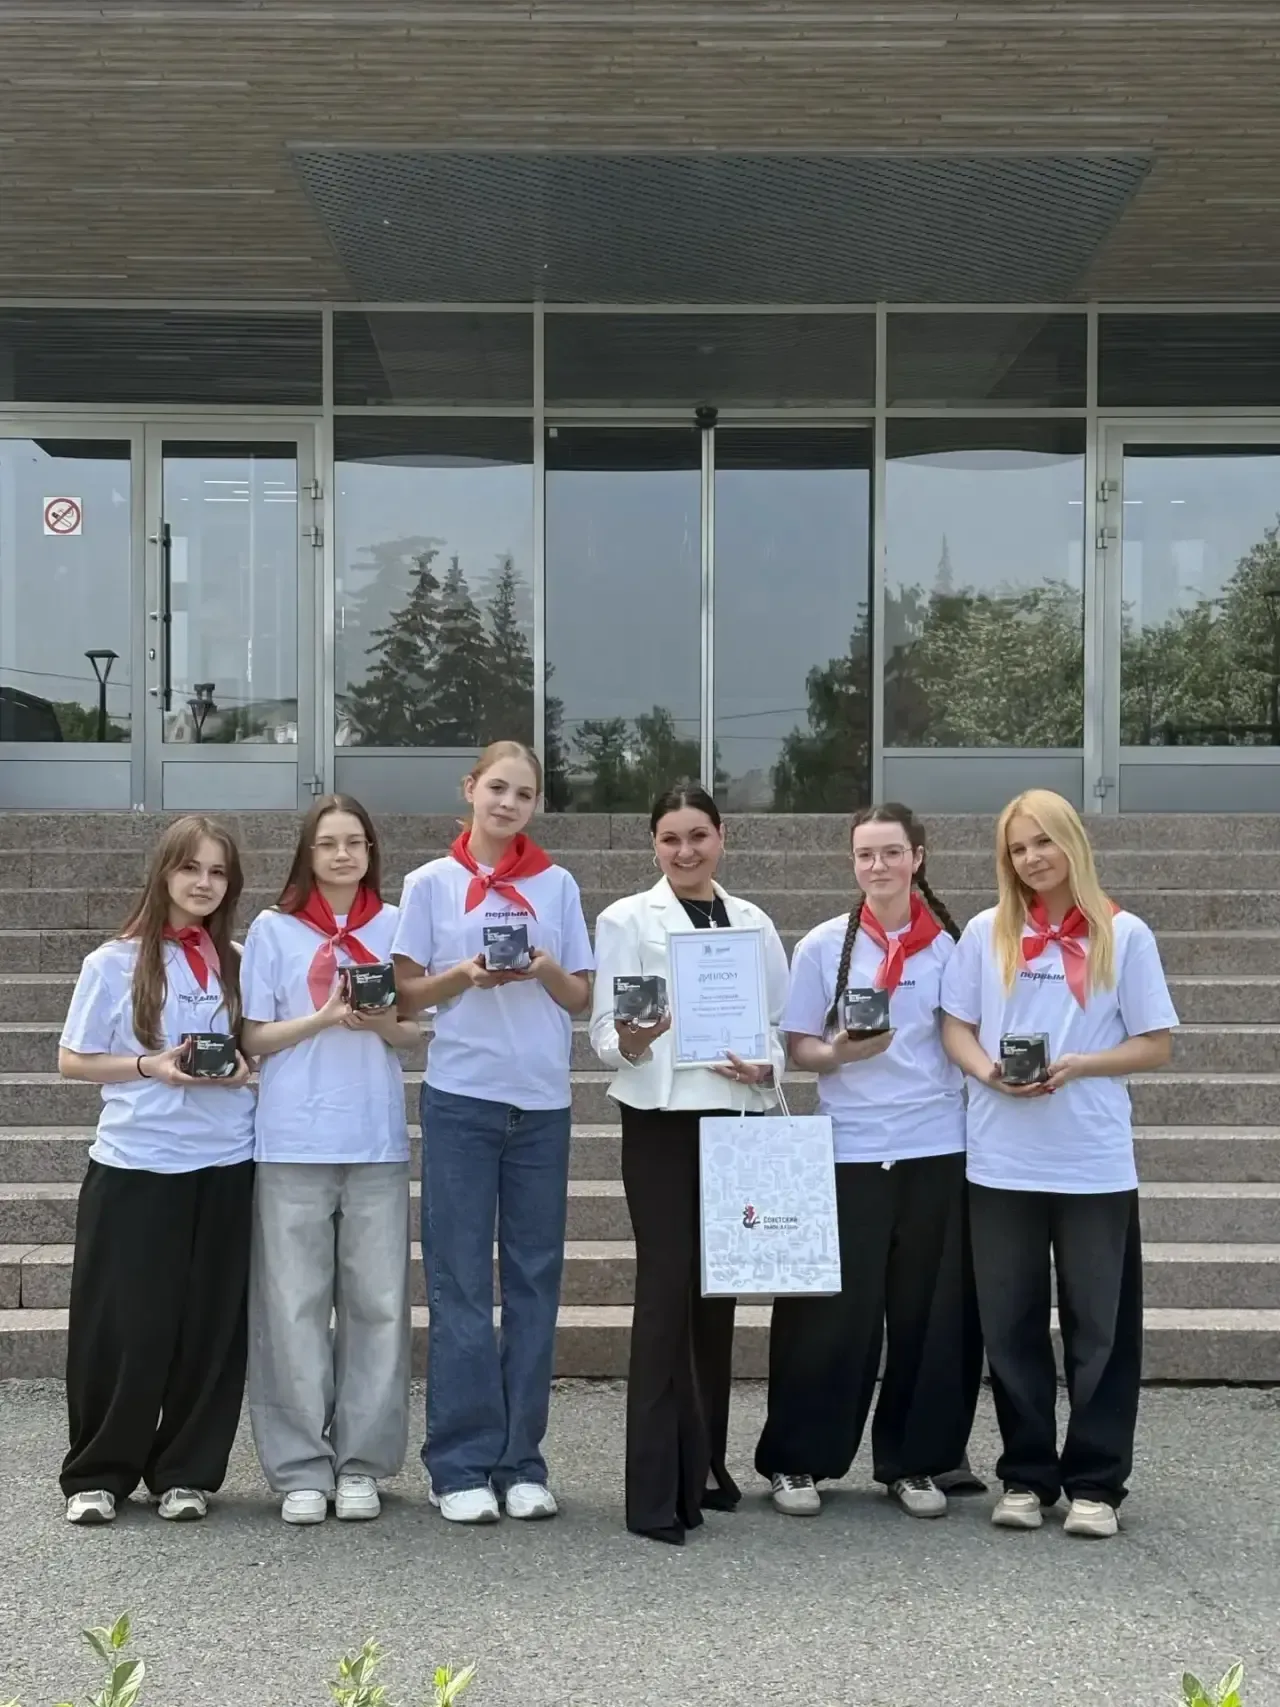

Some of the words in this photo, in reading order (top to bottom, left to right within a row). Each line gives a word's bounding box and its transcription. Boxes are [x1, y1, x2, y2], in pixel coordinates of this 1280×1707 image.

[485, 911, 528, 919] первым
[698, 972, 738, 983] ДИПЛОМ
[1020, 971, 1065, 981] первым
